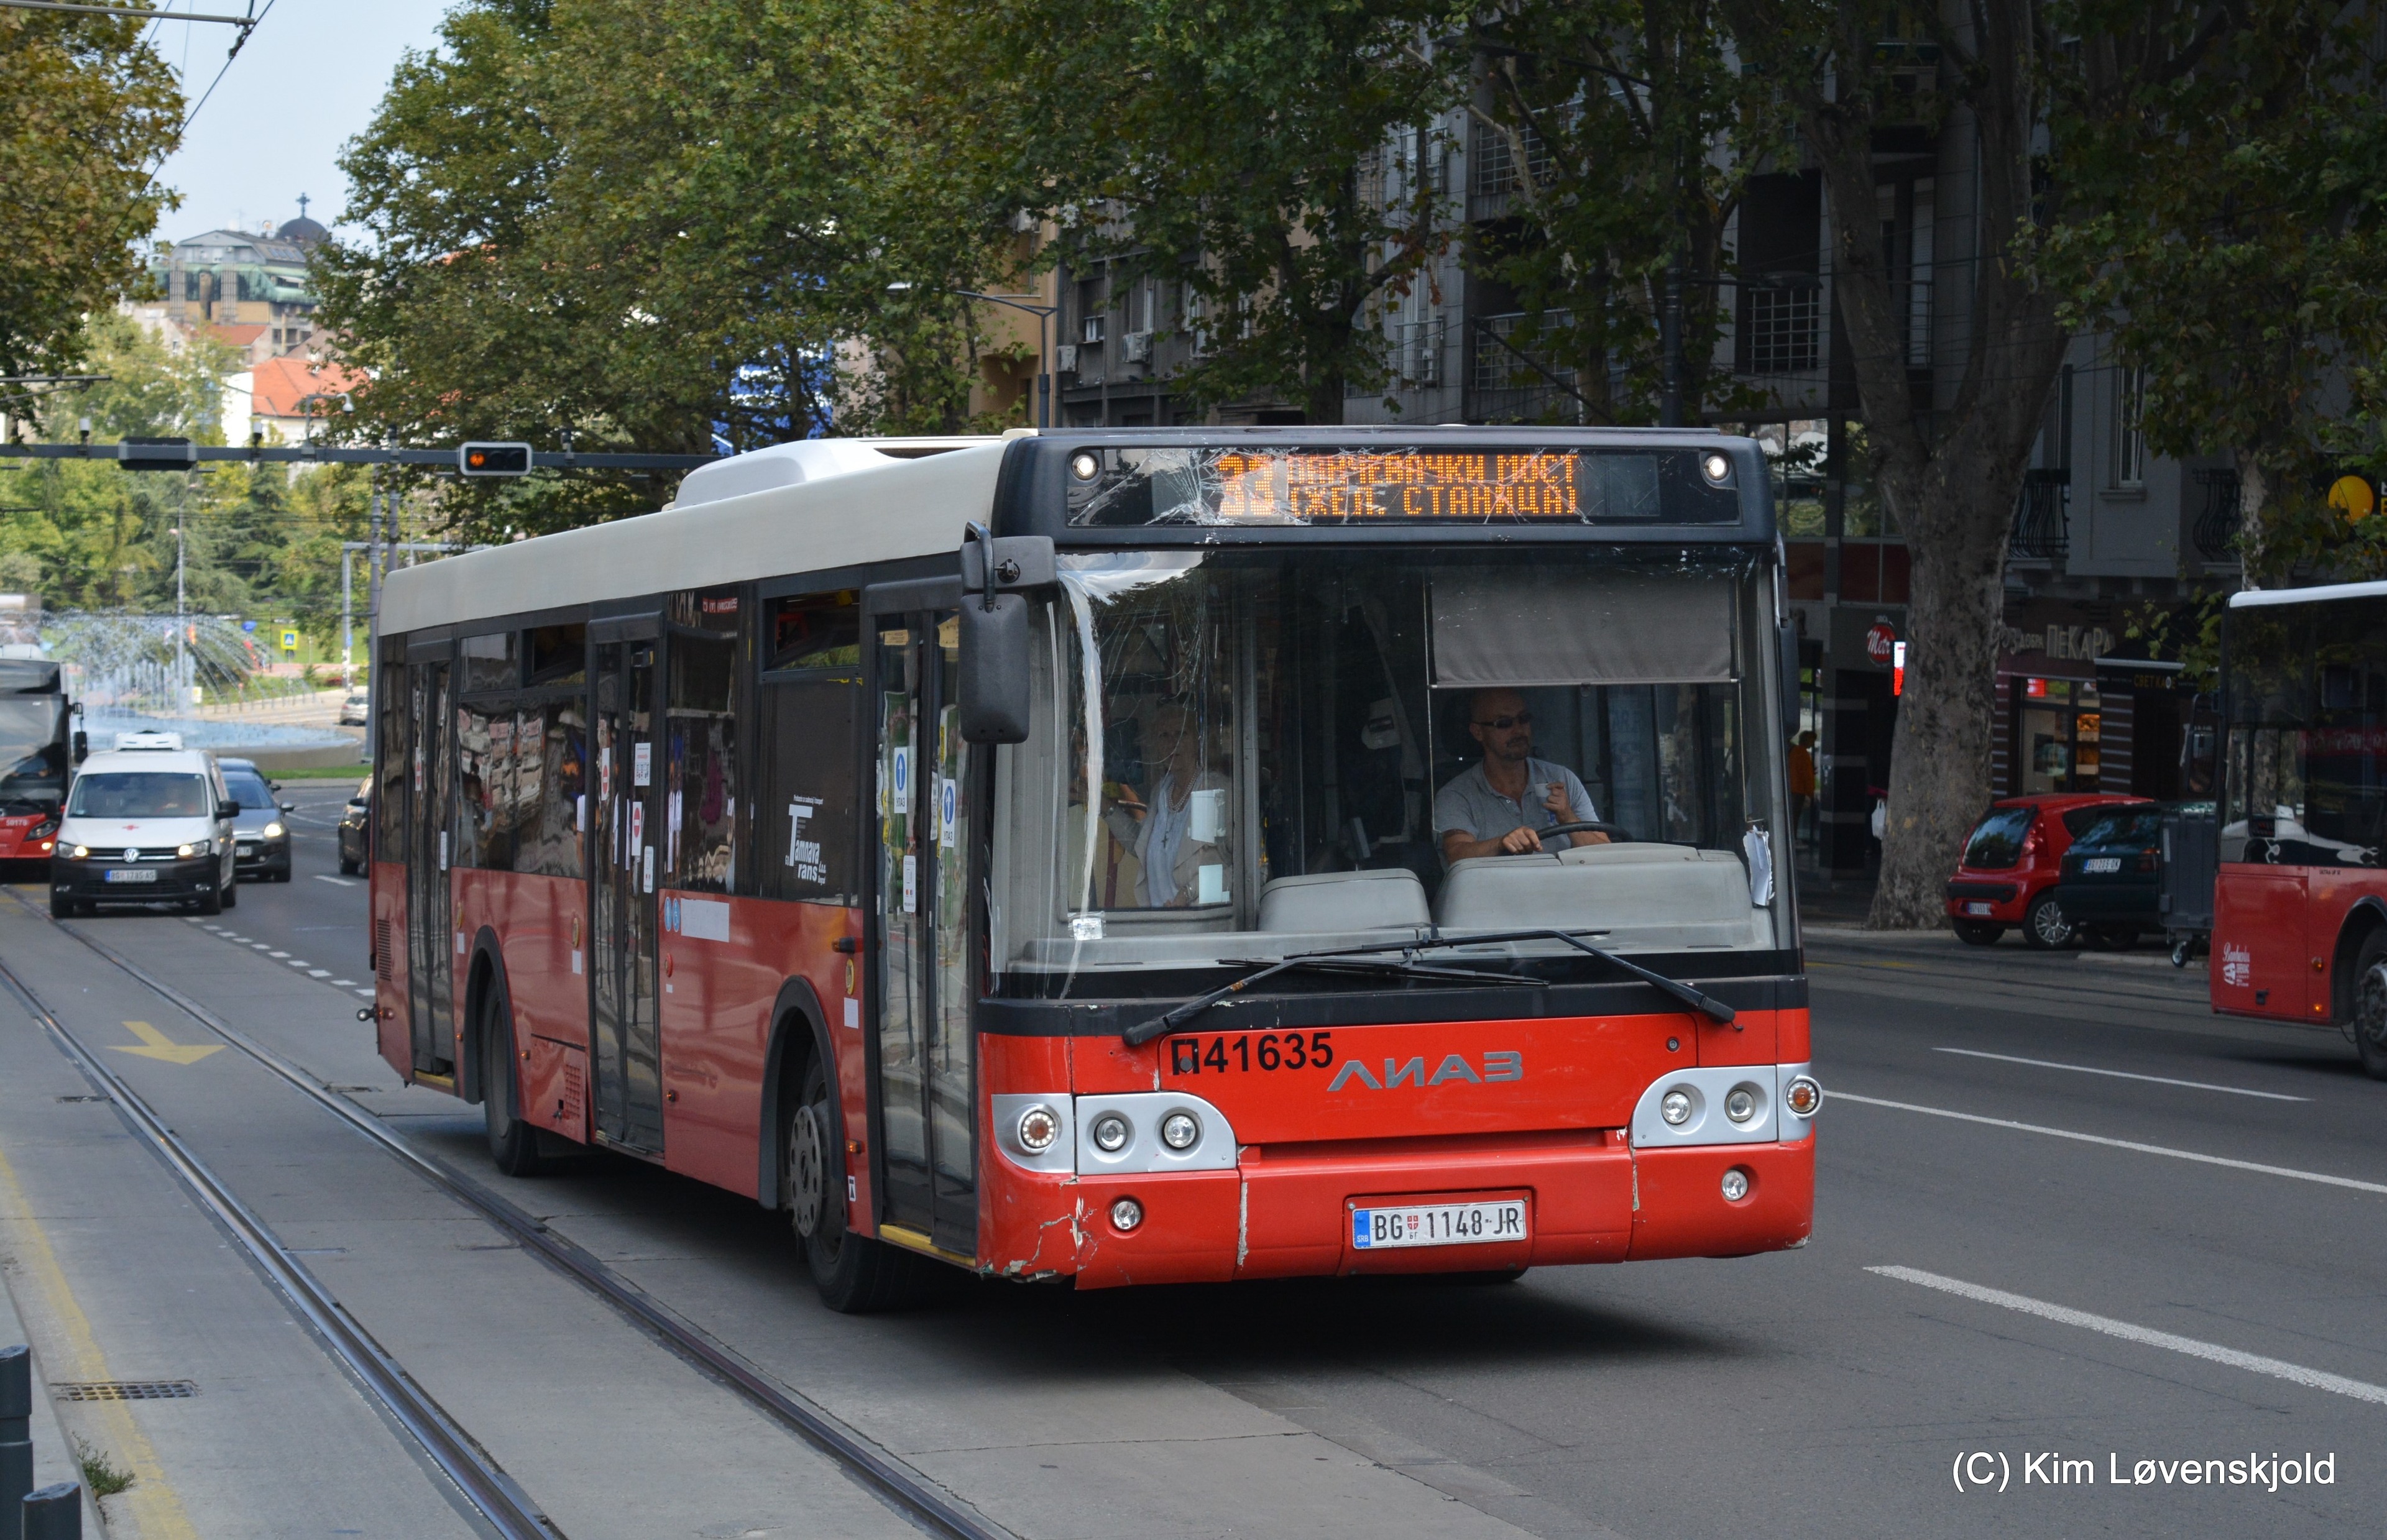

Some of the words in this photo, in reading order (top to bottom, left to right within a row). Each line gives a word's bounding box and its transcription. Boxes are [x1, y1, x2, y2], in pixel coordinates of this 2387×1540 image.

[1497, 455, 1578, 483] МОСТ
[896, 797, 905, 807] УЛАЗ
[944, 831, 952, 841] УЛАЗ
[1171, 1032, 1333, 1076] П41635
[1327, 1051, 1523, 1092] ЛИАЗ
[1356, 1235, 1369, 1243] SRB
[1374, 1214, 1402, 1242] BG
